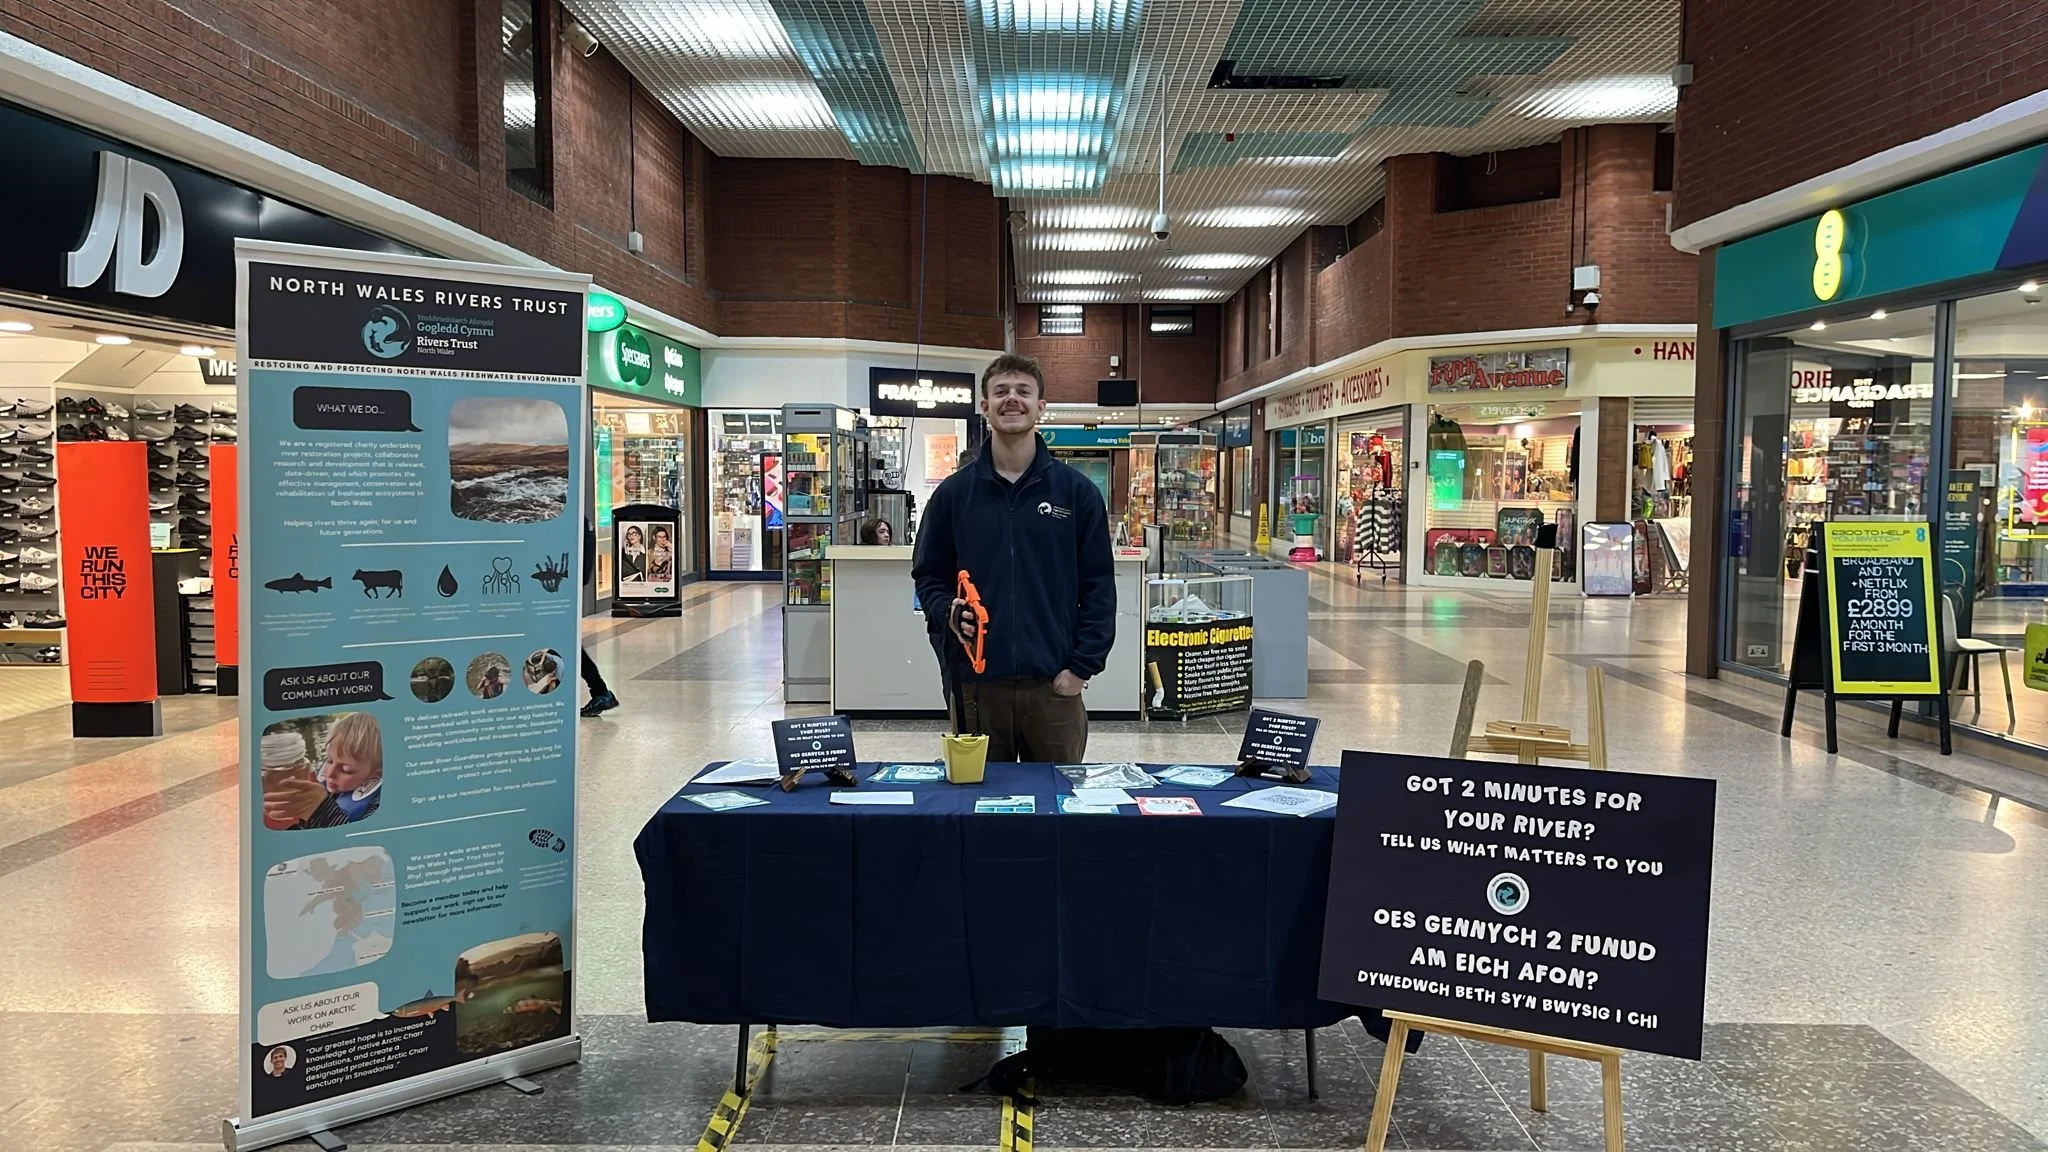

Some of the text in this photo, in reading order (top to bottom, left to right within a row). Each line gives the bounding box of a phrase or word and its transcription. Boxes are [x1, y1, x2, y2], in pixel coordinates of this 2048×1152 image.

[65, 150, 184, 298] JD
[270, 276, 344, 296] NORTH
[356, 284, 425, 303] WALES
[435, 291, 502, 310] RIVERS
[512, 298, 568, 315] TRUST
[417, 322, 494, 337] Gogledd Cymru
[417, 336, 478, 349] Rivers Trust
[437, 348, 455, 356] Wales
[621, 342, 651, 369] Specsavers
[254, 361, 309, 370] RESTORING
[337, 365, 393, 374] PROTECTING
[397, 368, 426, 376] NORTH
[430, 370, 458, 378] WALES
[460, 372, 514, 380] FRESHWATER
[517, 374, 576, 384] ENVIRONMENTS
[1430, 356, 1565, 390] Fifth Avenue
[878, 384, 972, 403] FRAGRANCE
[1341, 367, 1383, 406] ACCESSORIES
[316, 404, 386, 414] WHAT WE DO...
[84, 546, 119, 559] WE
[1842, 557, 1915, 566] BROADBAND
[80, 560, 124, 572] RUN
[1858, 567, 1903, 577] AND TV
[80, 572, 126, 586] THIS
[80, 586, 126, 600] CITY
[1864, 589, 1898, 599] FROM
[1147, 625, 1254, 647] Electronic Cigarettes
[1849, 631, 1896, 641] FOR THE
[1850, 620, 1904, 630] A MONTH
[1844, 642, 1875, 652] FIRST
[1878, 642, 1885, 652] 3
[280, 670, 370, 686] ASK US ABOUT OUR
[282, 685, 373, 700] COMMUNITY WORK!
[1406, 774, 1643, 812] GOT 2 MINUTES FOR
[1444, 809, 1596, 842] YOUR RIVER?
[1380, 832, 1664, 876] TELL US WHAT MATTERS TO YOU
[1372, 908, 1657, 962] OES GENNYCH 2 FUNUD
[1409, 946, 1600, 991] AM EICH AFON?
[283, 992, 360, 1015] ASK US ABOUT OUR
[1357, 969, 1658, 1030] DYWEDWCH BETH SY'N BWYSIG I CHI
[287, 1004, 356, 1026] WORK ON ARCTIC
[310, 1022, 334, 1032] CHAR!
[324, 1038, 356, 1052] greatest
[357, 1032, 376, 1044] hope
[377, 1031, 384, 1039] is
[384, 1028, 393, 1037] to
[394, 1021, 424, 1034] increase
[425, 1018, 437, 1026] our
[306, 1030, 424, 1064] knowledge of native Arctic Charr
[306, 1058, 352, 1074] populations,
[354, 1052, 369, 1062] and
[370, 1046, 393, 1058] create
[306, 1046, 430, 1082] designated protected Arctic Charr
[306, 1078, 344, 1092] sanctuary
[345, 1074, 352, 1082] in
[353, 1064, 394, 1080] Snowdonia
